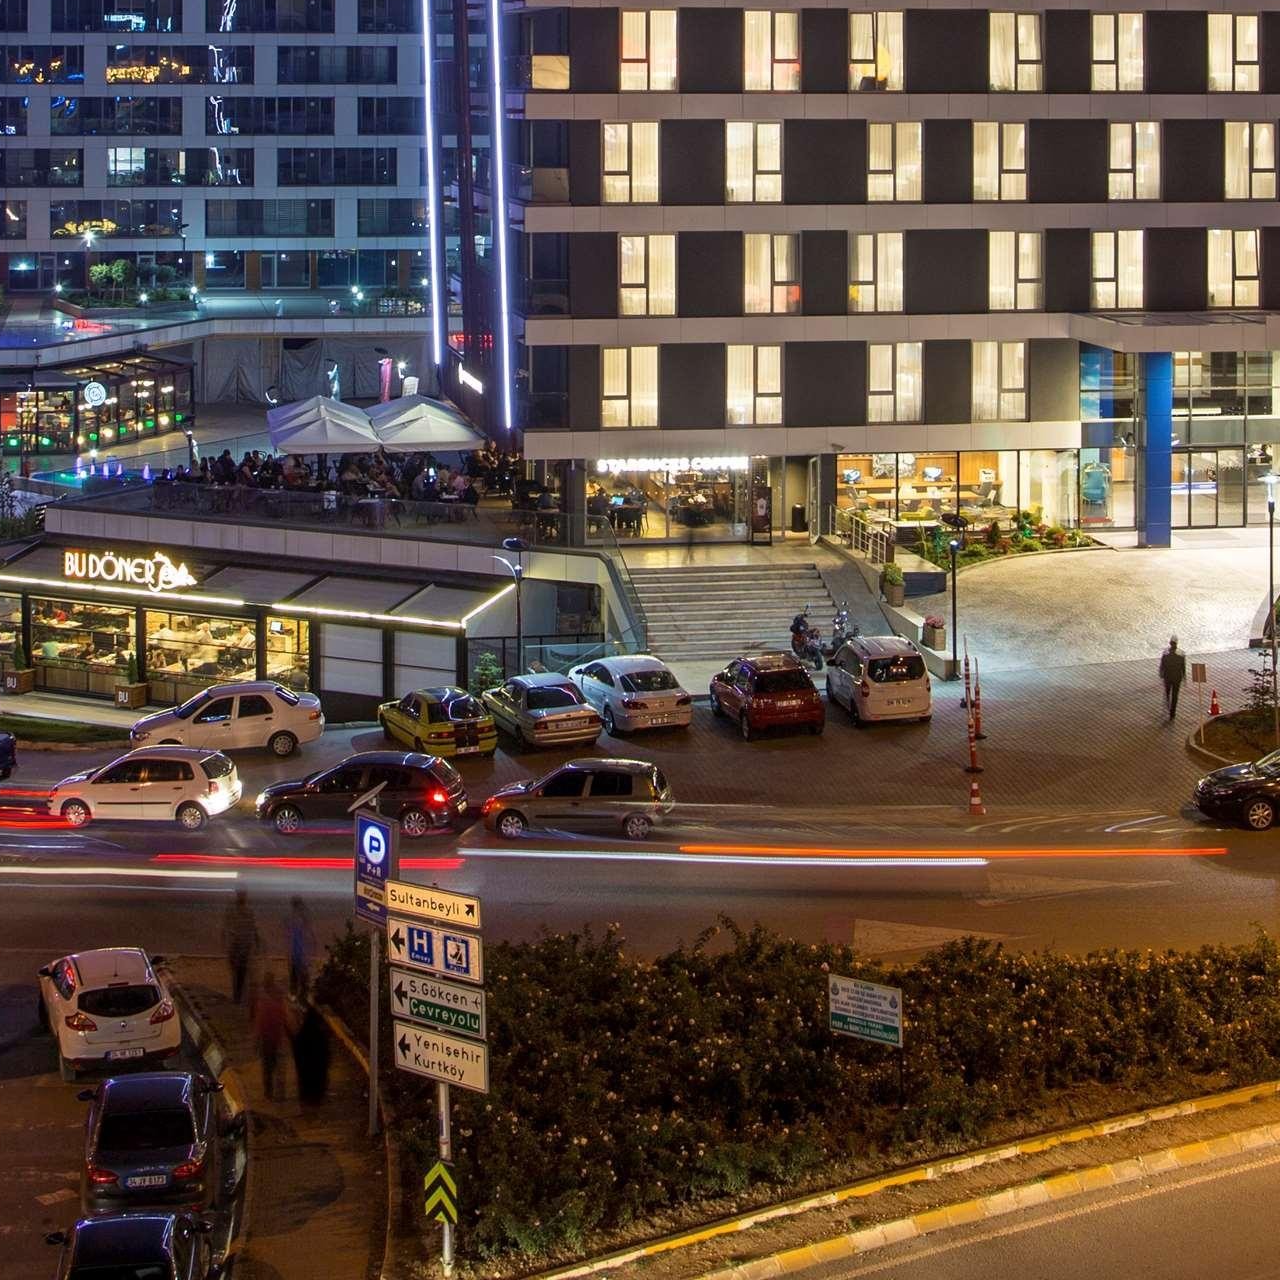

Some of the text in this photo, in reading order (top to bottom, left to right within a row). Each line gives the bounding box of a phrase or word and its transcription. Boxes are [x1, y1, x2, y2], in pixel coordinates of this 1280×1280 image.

[65, 551, 155, 584] BU DÖNER
[369, 835, 381, 853] P
[390, 889, 459, 916] Sultanbeyli
[413, 928, 427, 953] H
[409, 980, 468, 1005] S.Gökçen
[410, 999, 479, 1029] Çevreyolu
[414, 1034, 481, 1063] Yenişehir
[414, 1053, 464, 1080] Kurtköy
